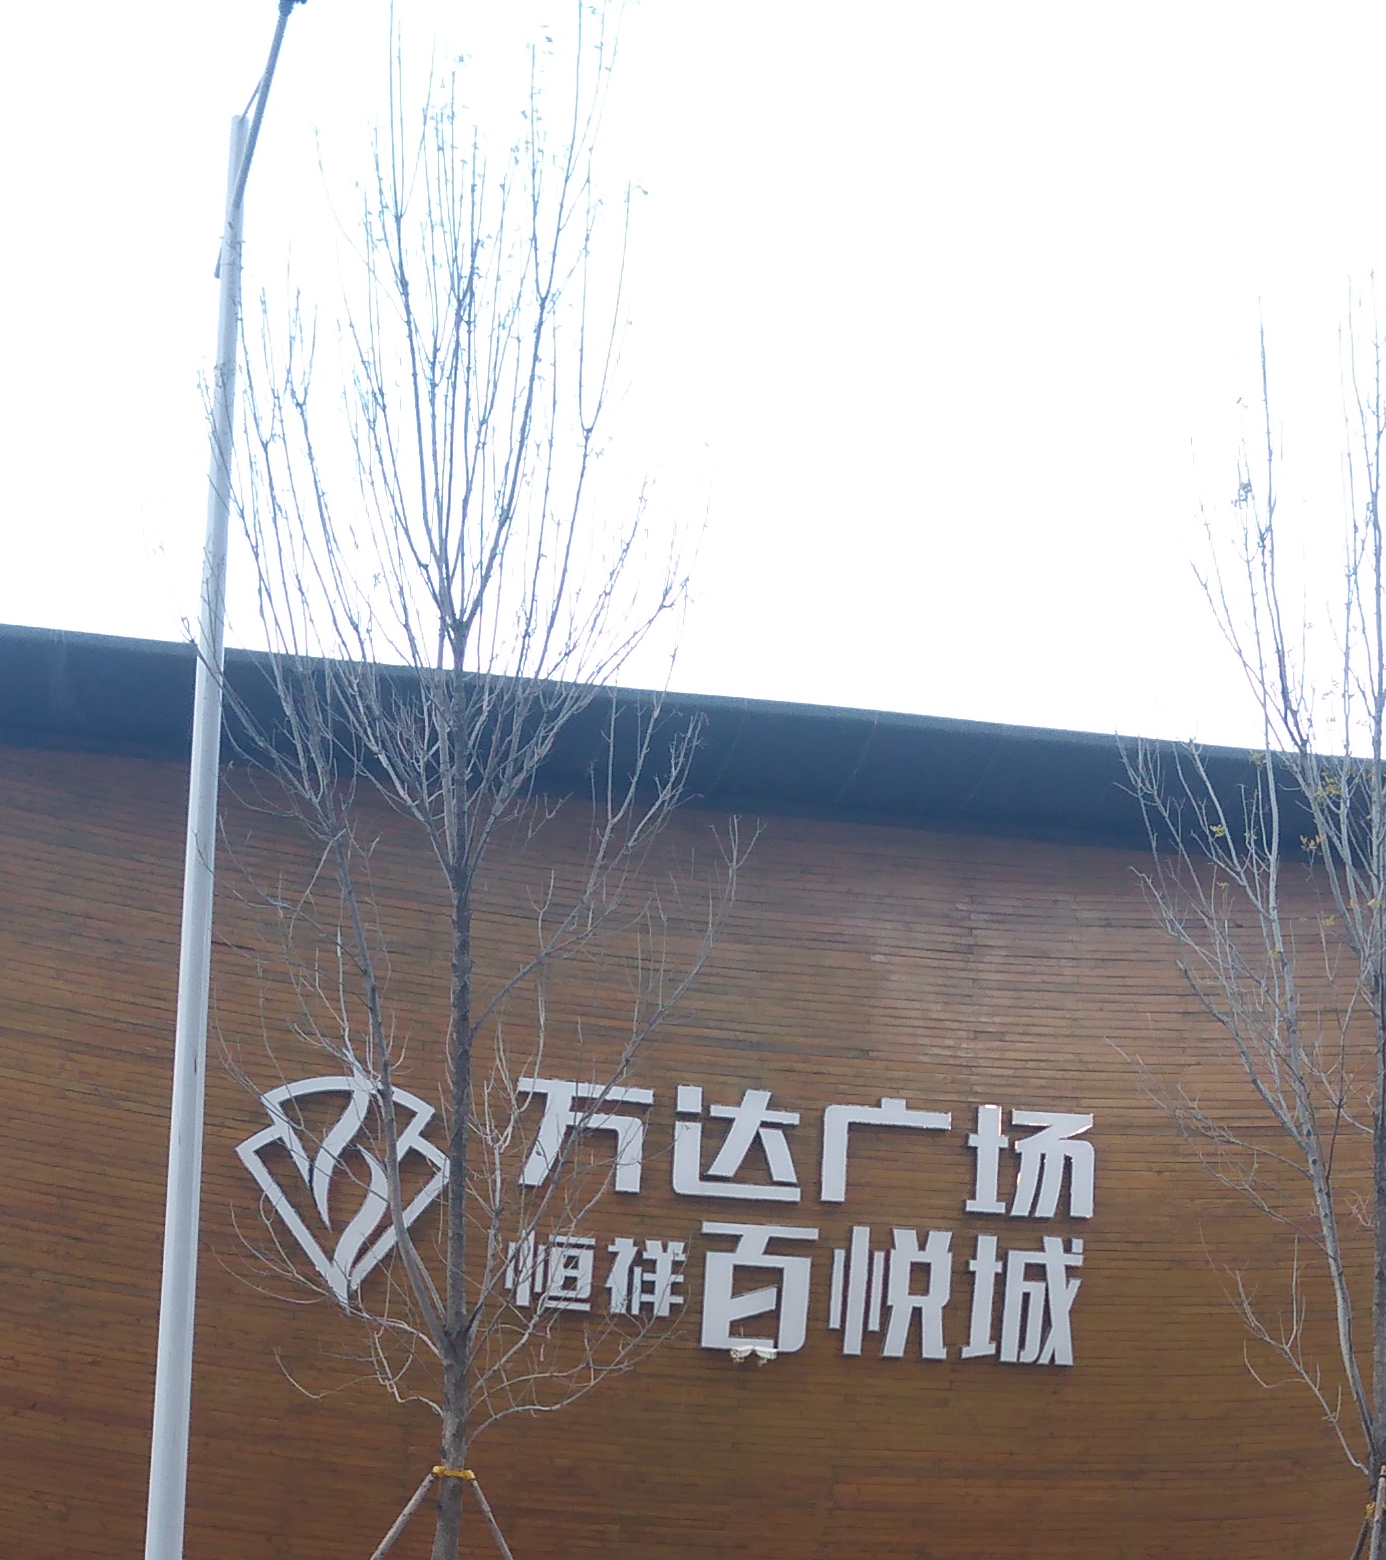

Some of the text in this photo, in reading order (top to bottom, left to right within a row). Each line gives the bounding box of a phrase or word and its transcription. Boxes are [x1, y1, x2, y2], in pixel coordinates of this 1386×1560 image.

[517, 1076, 1095, 1219] 万达广场
[503, 1220, 1085, 1368] 恒祥百悦城
